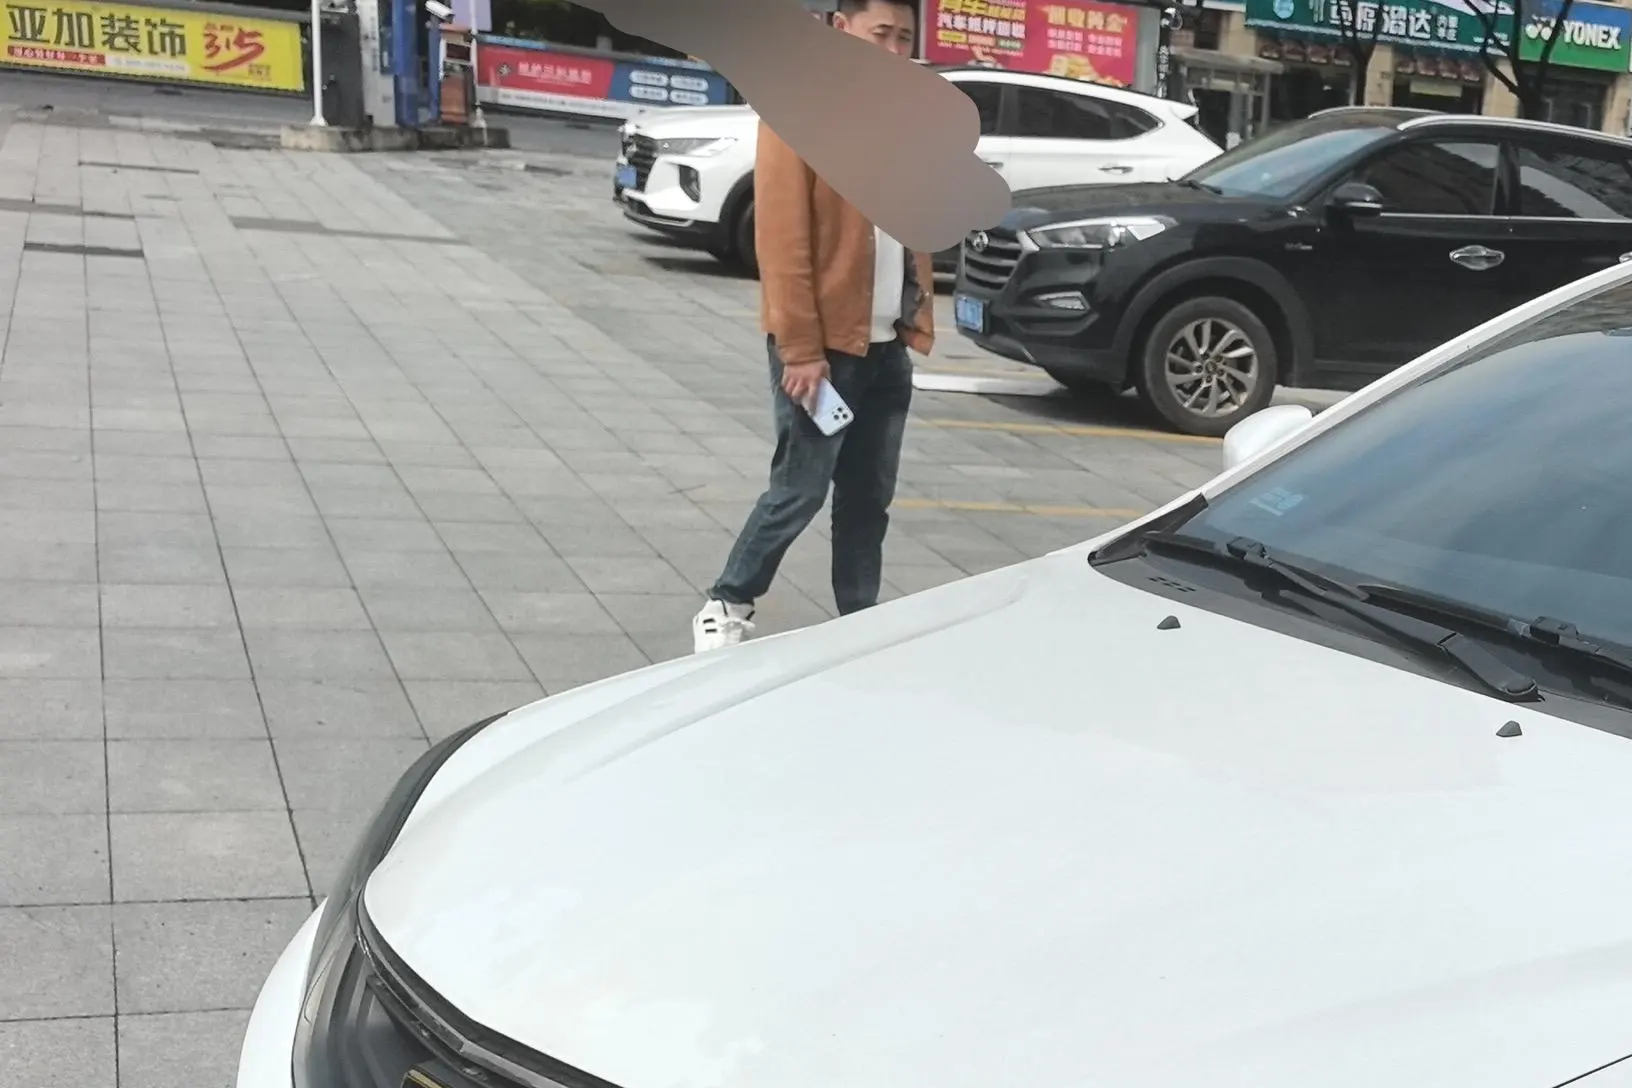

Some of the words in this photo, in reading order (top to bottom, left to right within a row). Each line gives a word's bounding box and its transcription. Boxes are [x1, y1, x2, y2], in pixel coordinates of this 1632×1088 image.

[6, 4, 187, 57] 亚加装饰
[1562, 20, 1622, 50] YONEX
